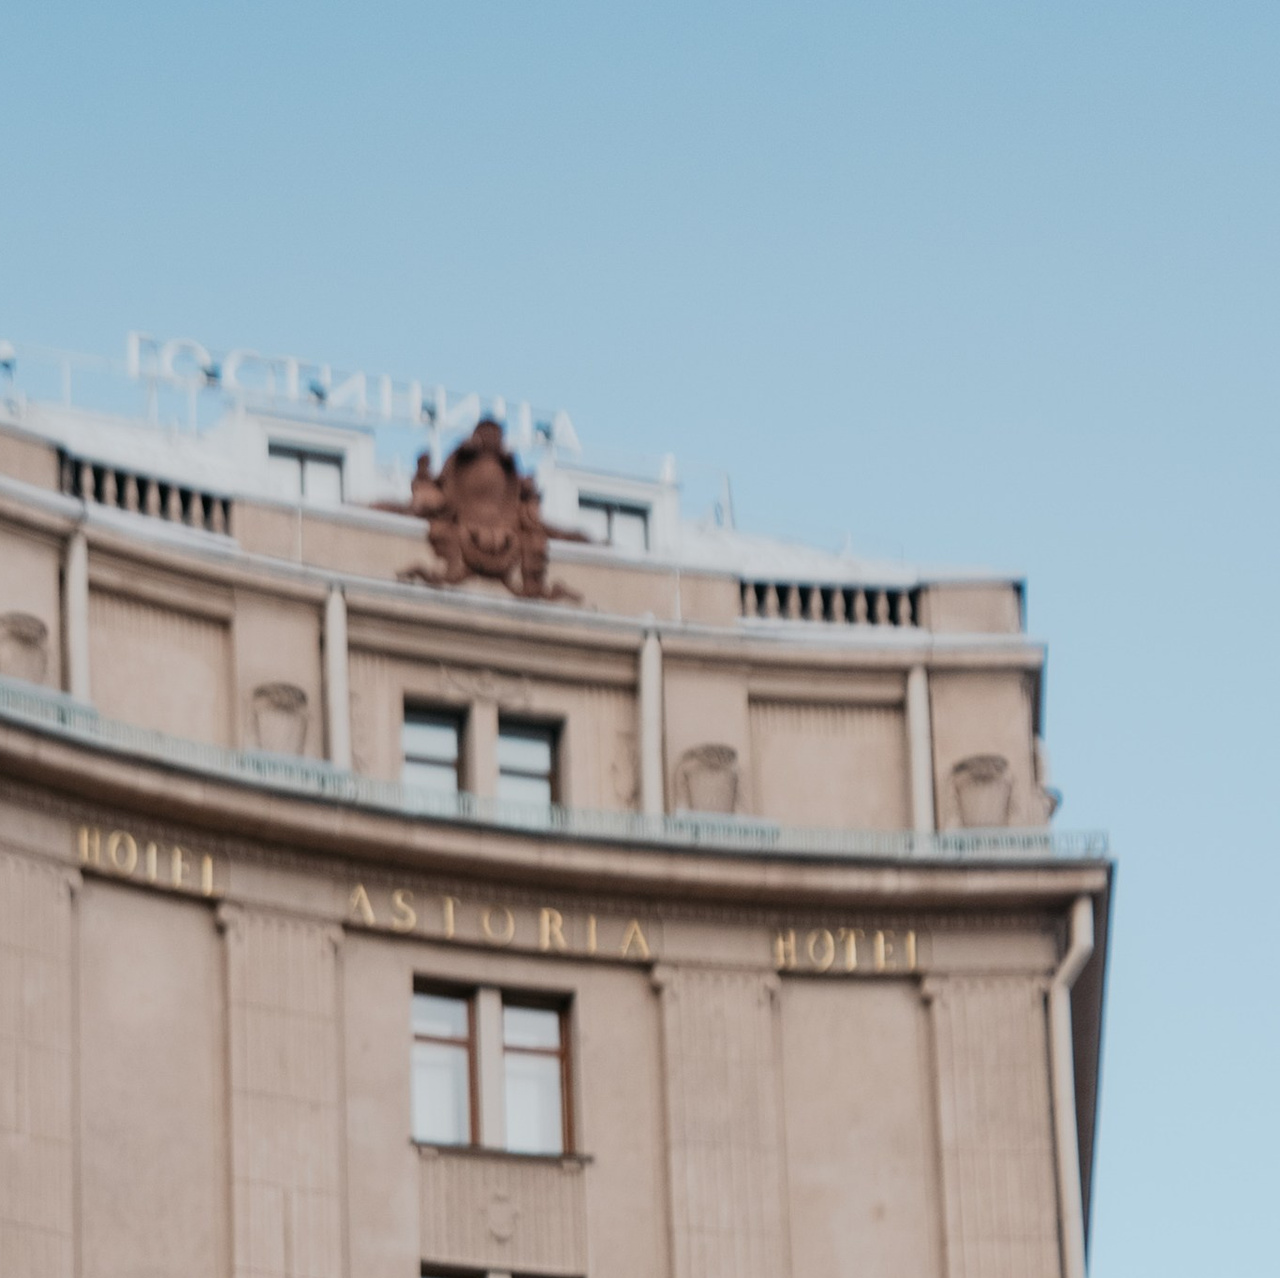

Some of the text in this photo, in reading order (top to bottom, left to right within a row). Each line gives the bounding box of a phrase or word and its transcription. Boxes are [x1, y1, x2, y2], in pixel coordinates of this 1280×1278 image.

[77, 825, 922, 973] HOTEL ASTORIA HOTEL
